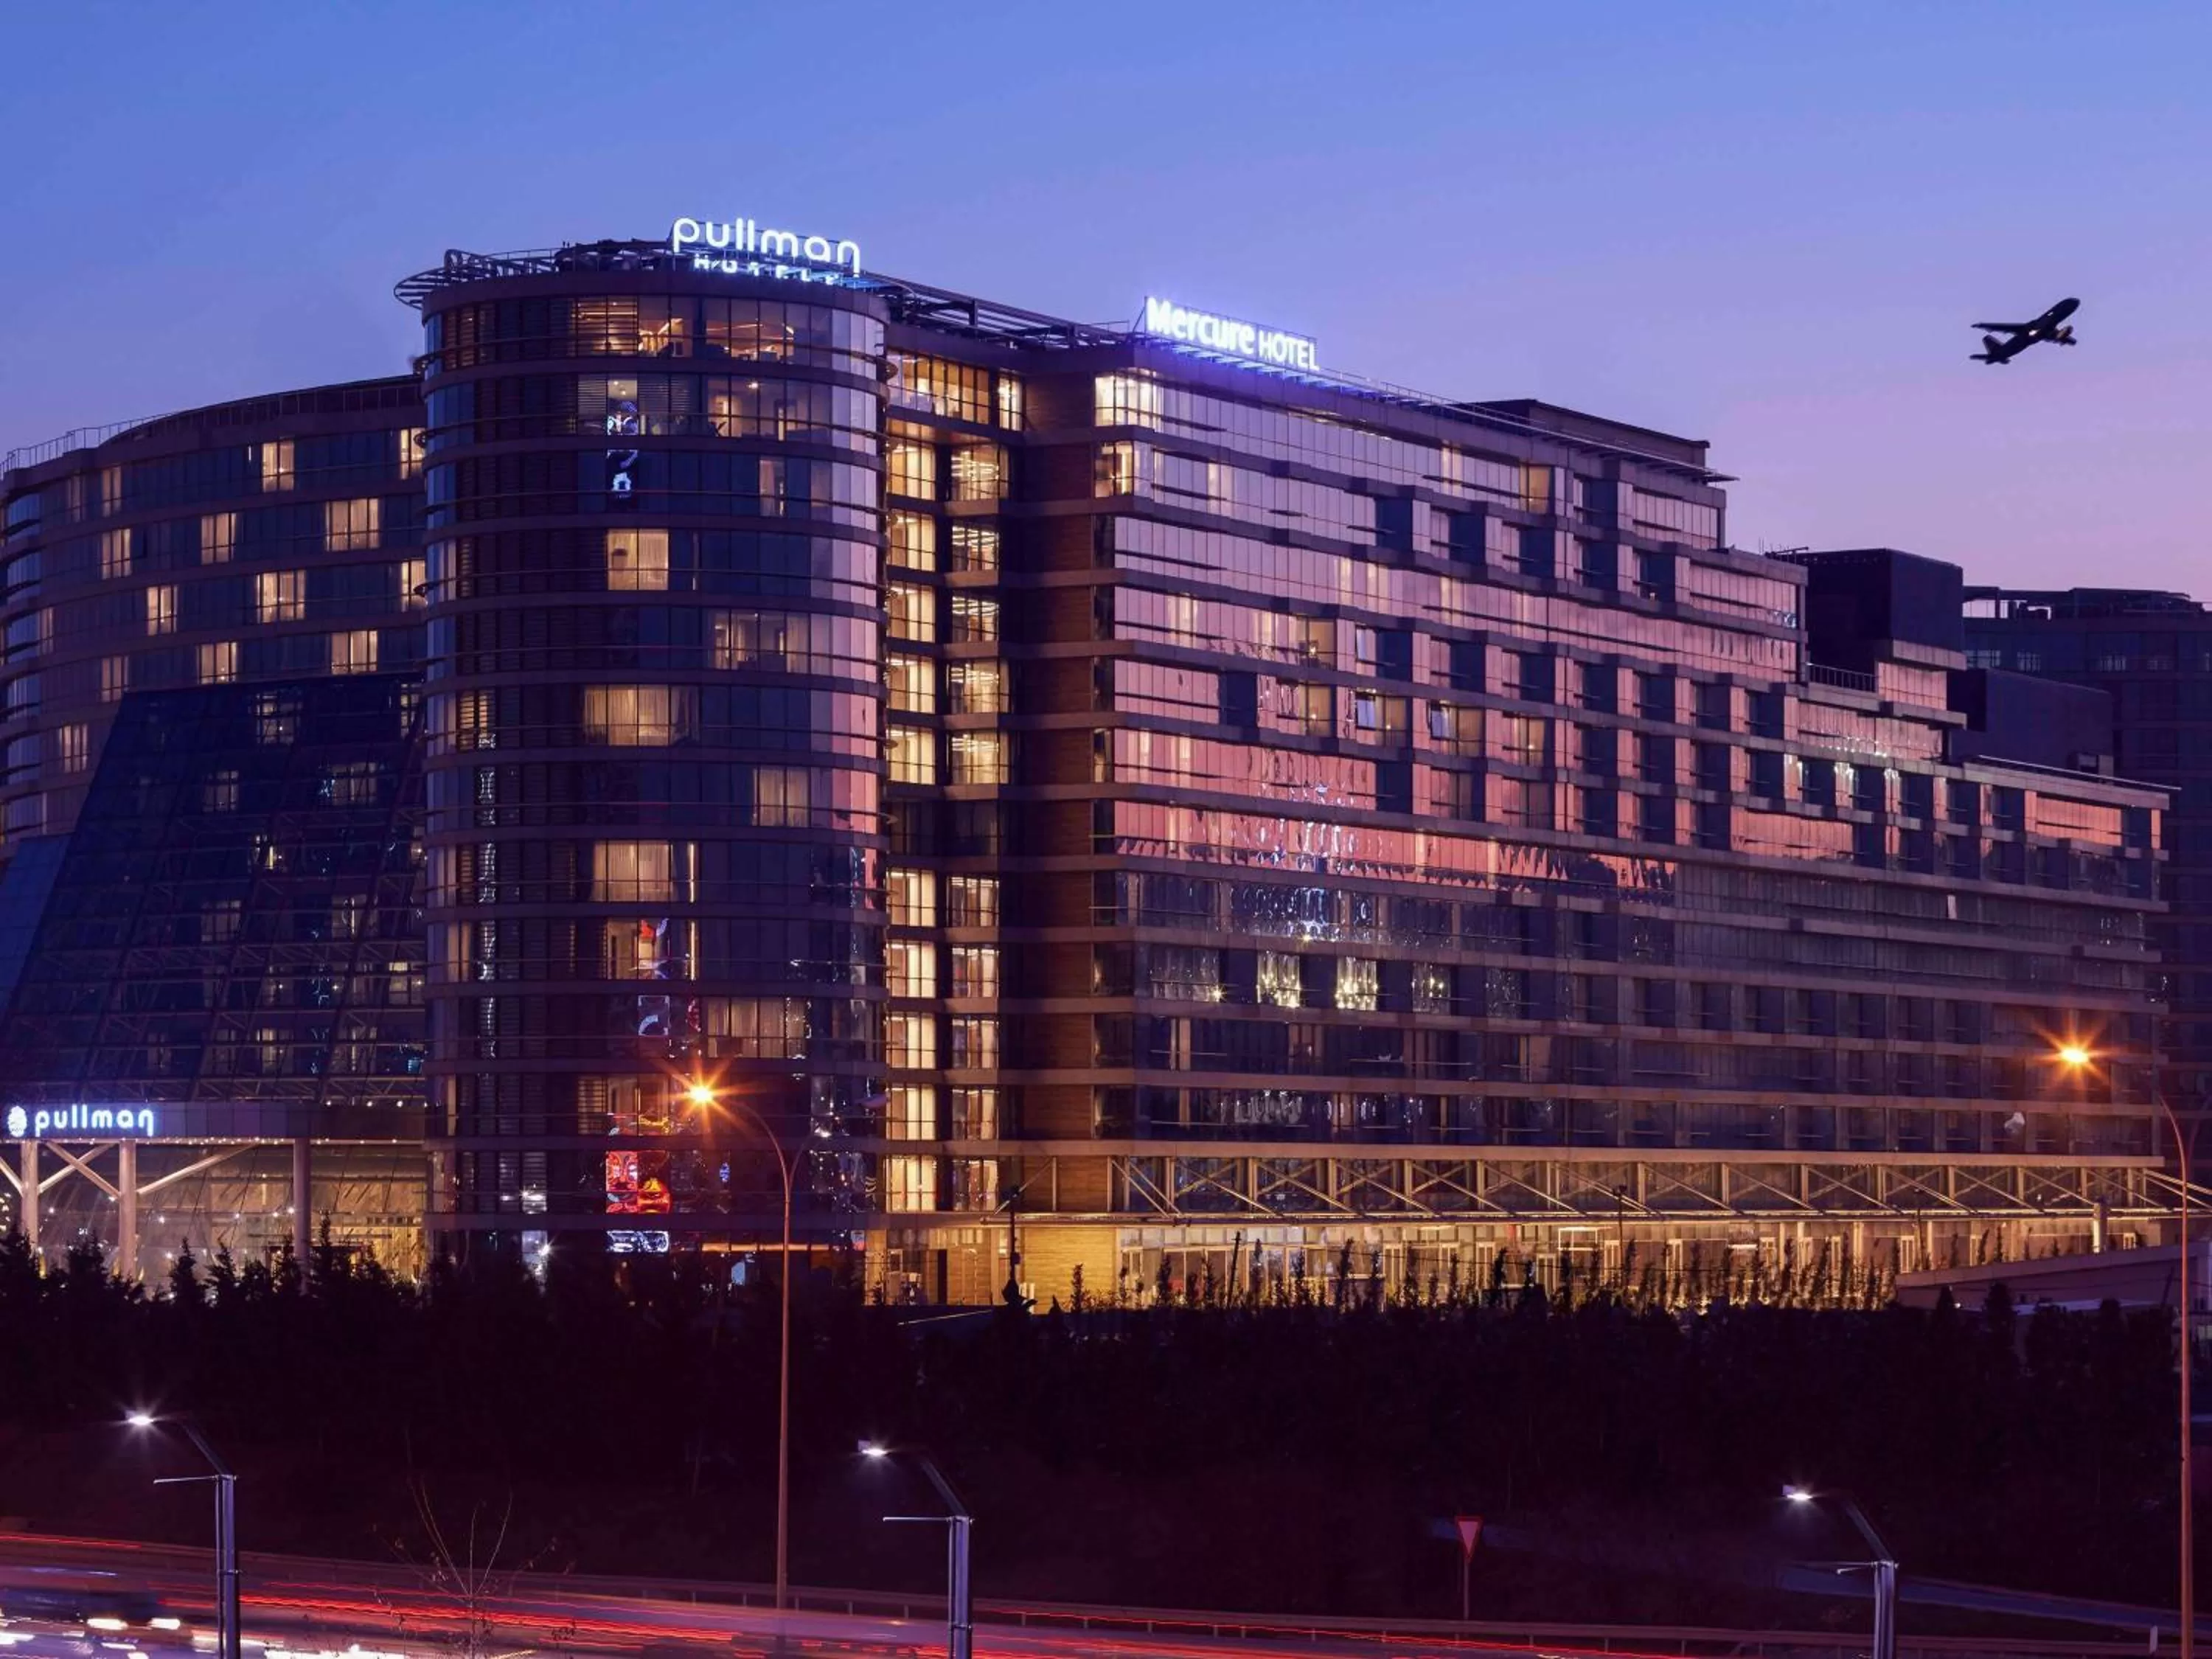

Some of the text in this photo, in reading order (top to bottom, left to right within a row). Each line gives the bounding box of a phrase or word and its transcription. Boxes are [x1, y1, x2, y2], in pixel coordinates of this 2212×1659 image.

[672, 218, 860, 278] pullman
[1147, 296, 1319, 370] Mercure HOTEL
[35, 1104, 153, 1137] pullman
